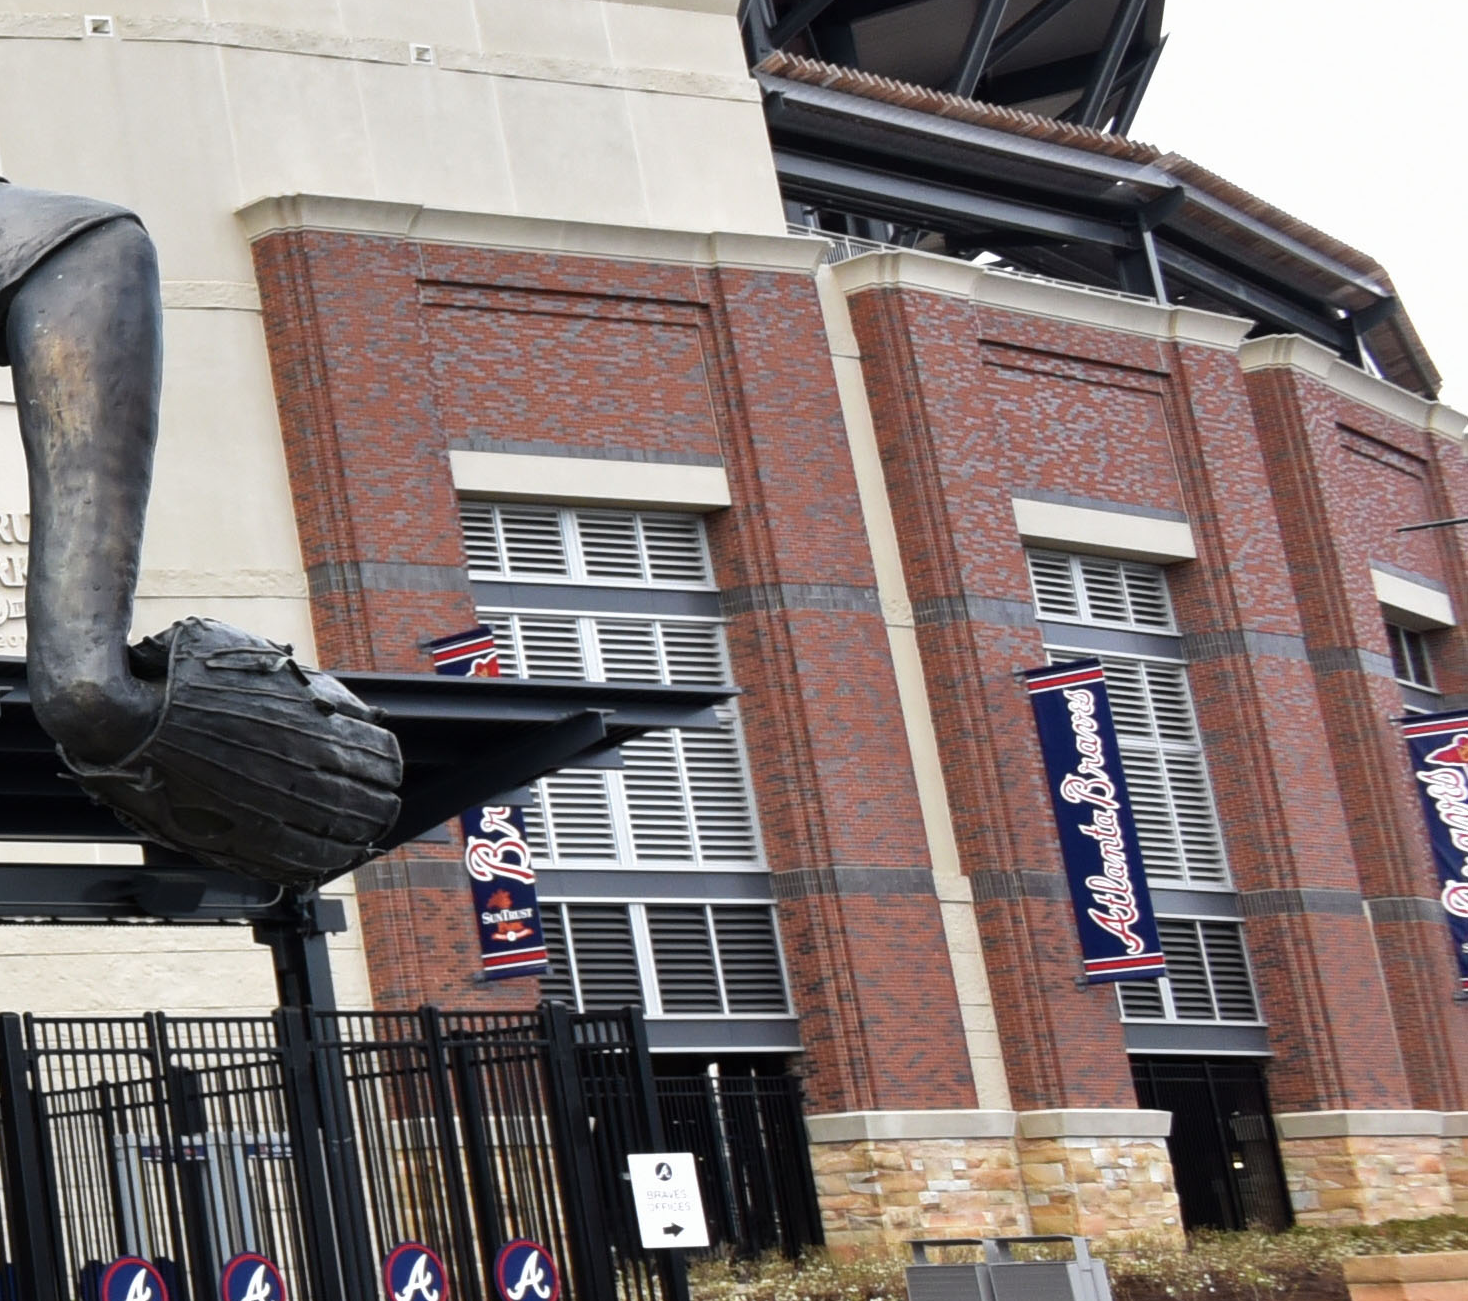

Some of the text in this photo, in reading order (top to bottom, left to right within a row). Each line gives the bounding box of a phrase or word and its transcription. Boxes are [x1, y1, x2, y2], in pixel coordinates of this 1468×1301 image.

[12, 601, 26, 614] TH
[1060, 687, 1145, 955] Atlanta Braves
[507, 1250, 550, 1300] A
